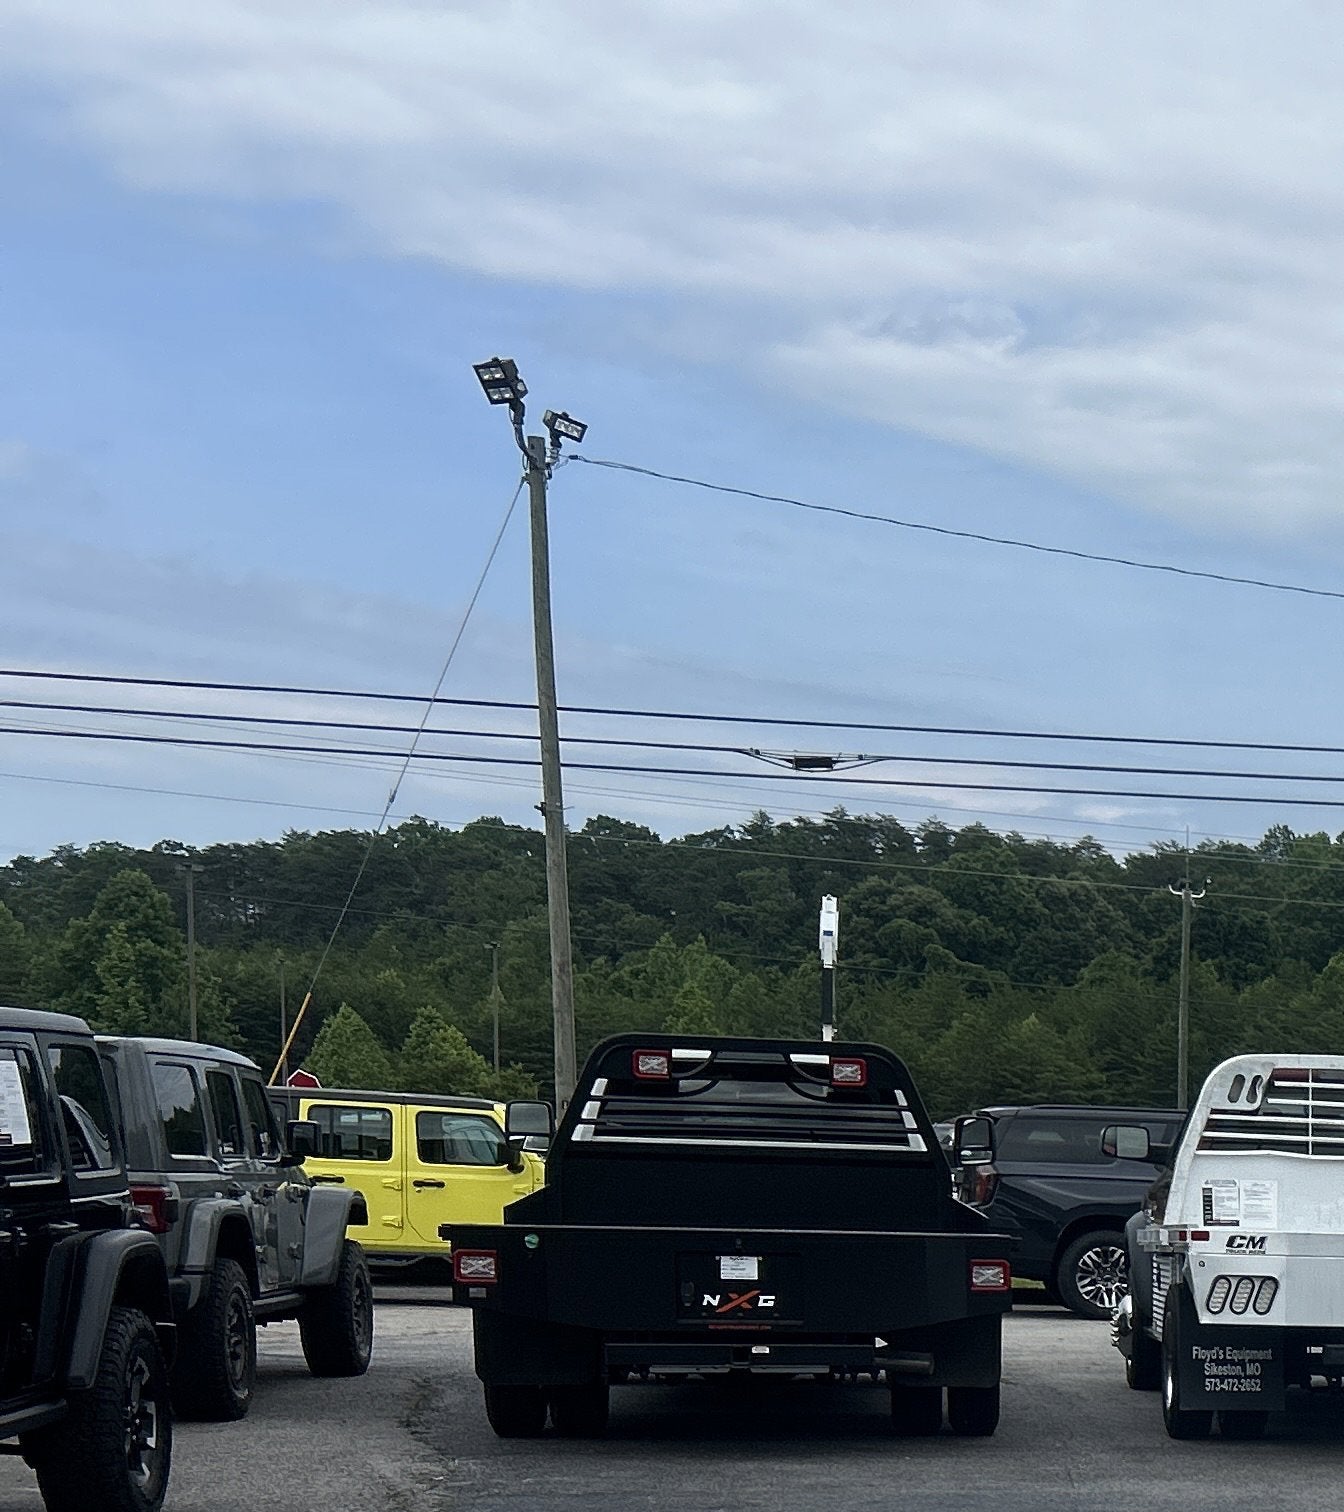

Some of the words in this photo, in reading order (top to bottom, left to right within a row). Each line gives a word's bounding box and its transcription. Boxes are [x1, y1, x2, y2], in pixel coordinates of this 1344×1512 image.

[1226, 1235, 1268, 1249] CM
[1192, 1346, 1224, 1362] Floyd's
[1225, 1346, 1273, 1362] Equipment
[1204, 1362, 1245, 1377] Sikeston,
[1246, 1362, 1261, 1376] MO
[1205, 1378, 1261, 1392] 573-472-2652
